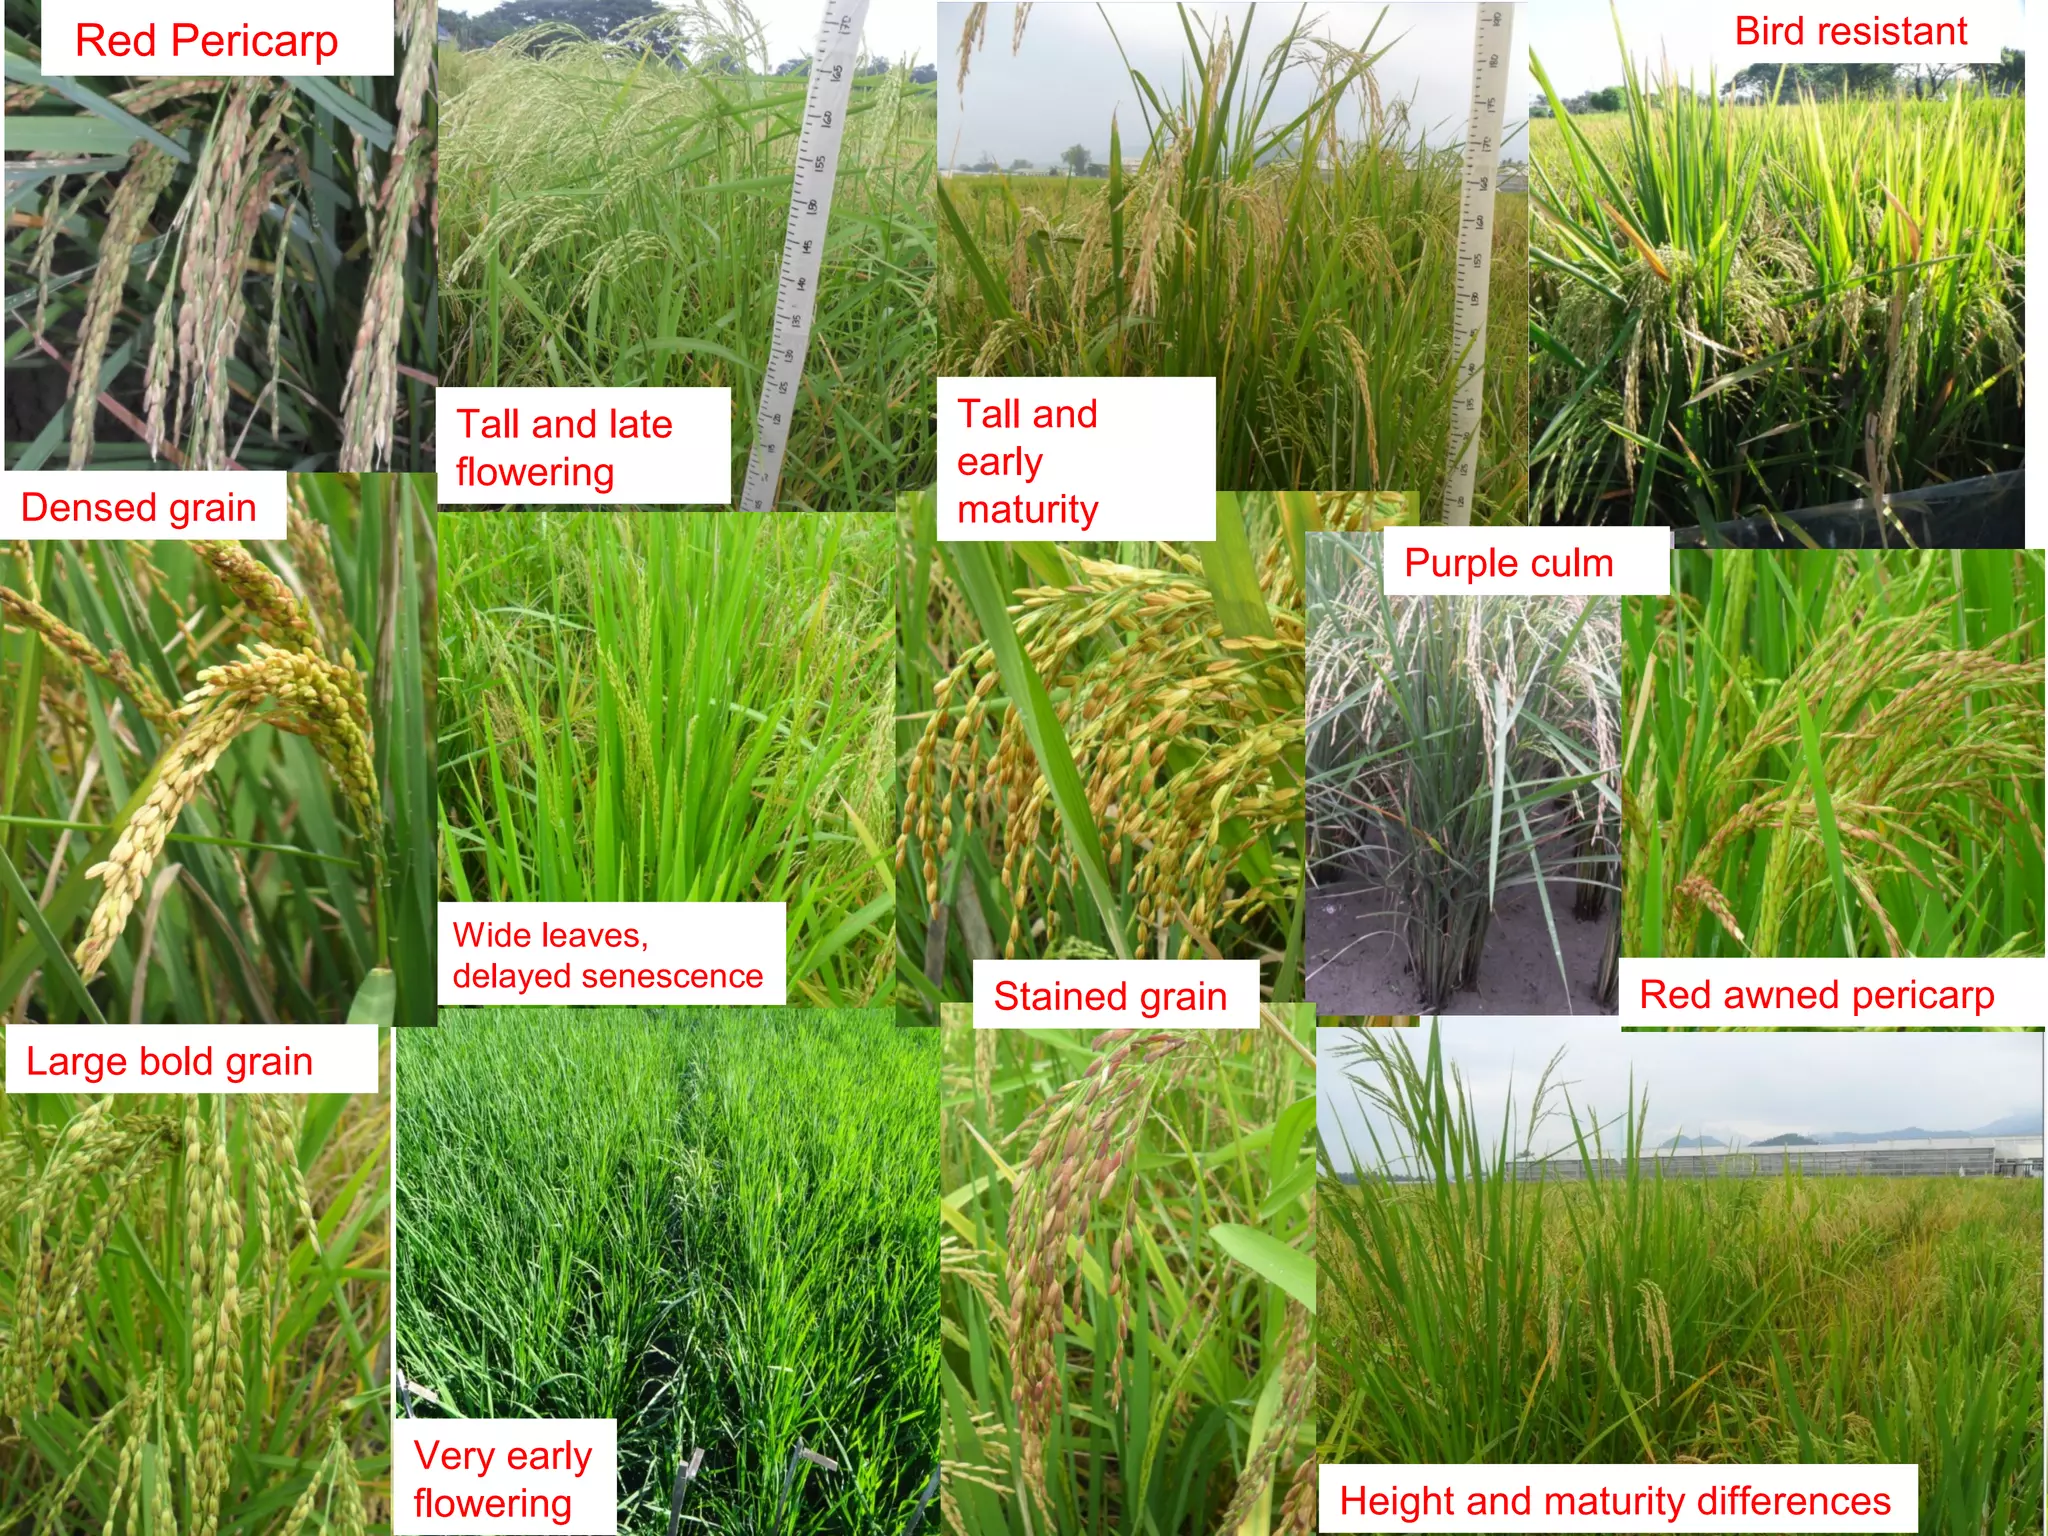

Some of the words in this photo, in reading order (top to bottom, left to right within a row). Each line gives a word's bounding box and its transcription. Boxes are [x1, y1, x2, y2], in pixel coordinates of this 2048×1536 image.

[837, 15, 852, 35] 170
[1489, 54, 1499, 69] 180
[830, 65, 843, 82] 165
[1487, 97, 1496, 113] 175
[821, 111, 832, 128] 160
[1481, 136, 1492, 153] 170
[814, 155, 826, 173] 155
[1479, 176, 1489, 191] 165
[806, 199, 818, 215] 150
[1475, 215, 1485, 230] 160
[802, 240, 813, 254] 145
[1473, 253, 1482, 268] 155
[796, 277, 807, 291] 140
[791, 314, 802, 329] 135
[784, 349, 795, 363] 130
[778, 381, 789, 394] 125
[1466, 398, 1475, 411] 135
[772, 413, 782, 425] 120
[1460, 464, 1469, 477] 125
[1457, 495, 1465, 508] 120
